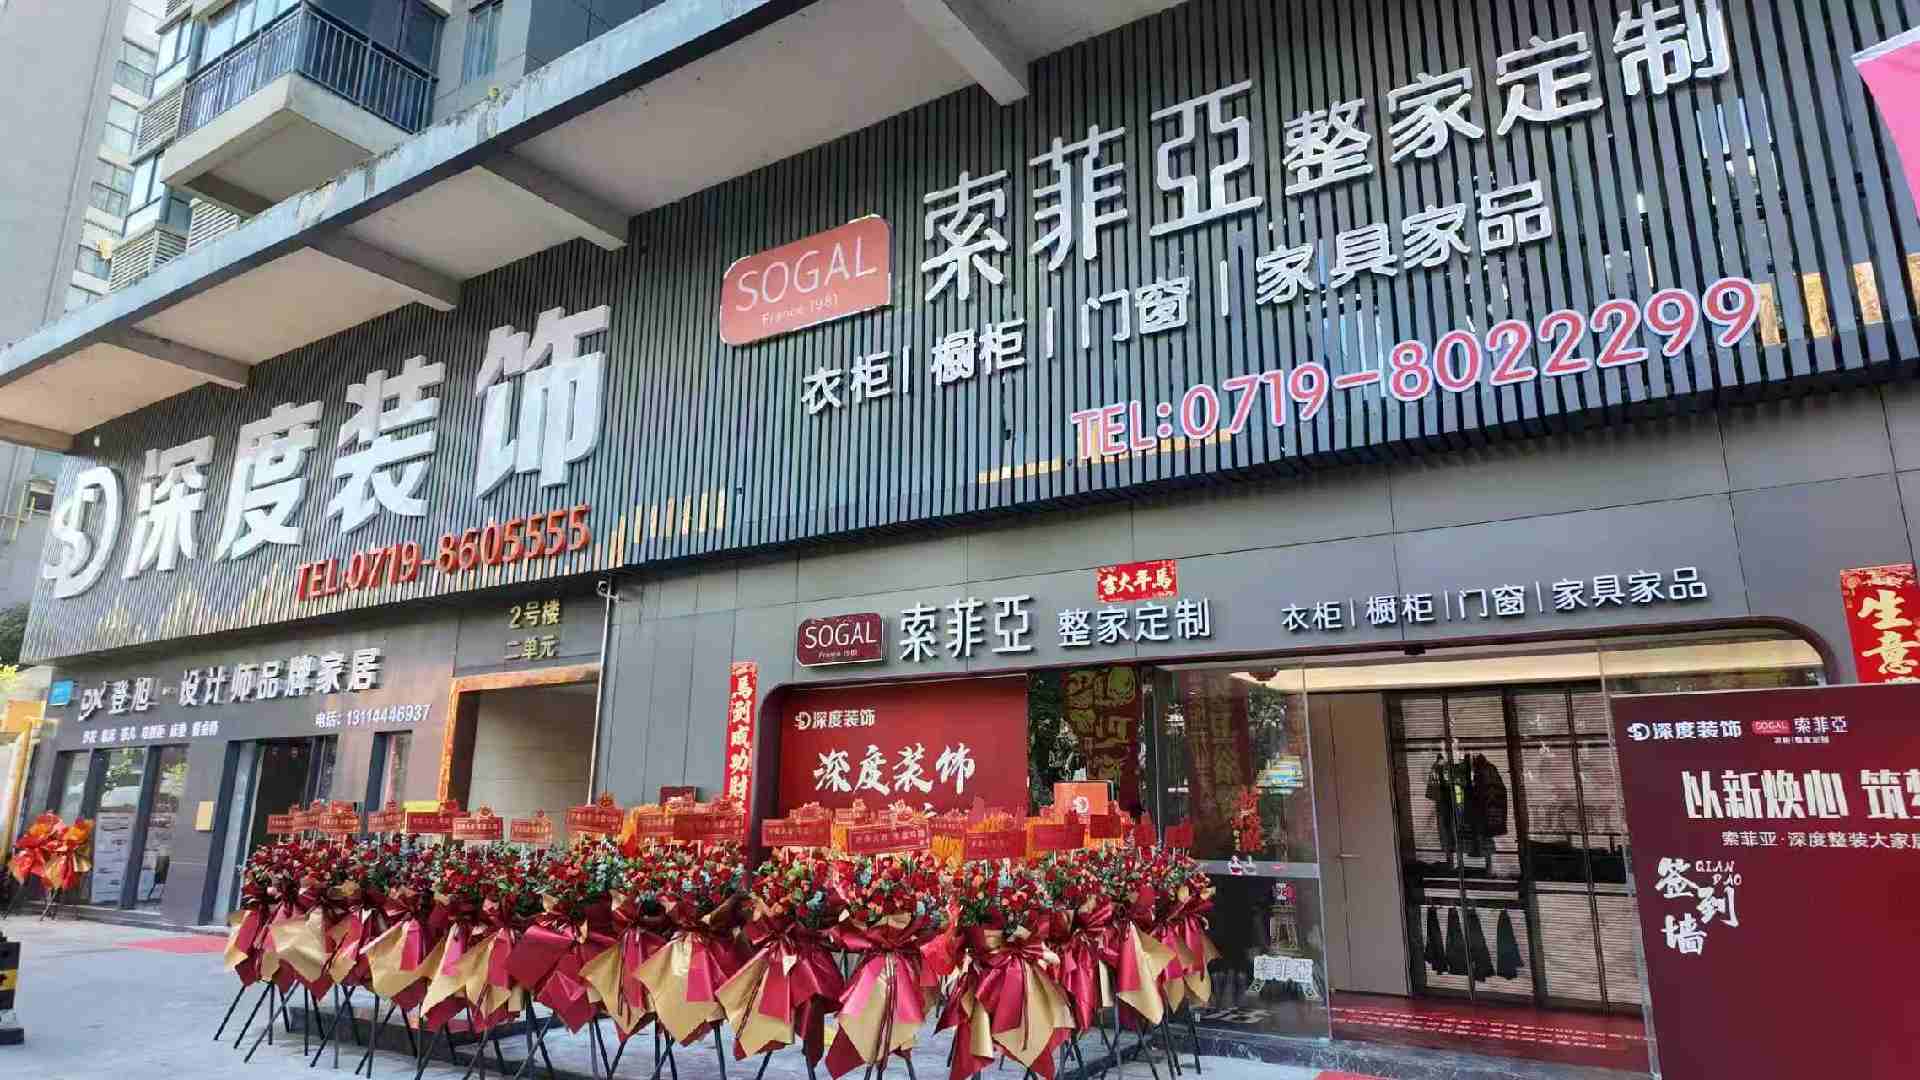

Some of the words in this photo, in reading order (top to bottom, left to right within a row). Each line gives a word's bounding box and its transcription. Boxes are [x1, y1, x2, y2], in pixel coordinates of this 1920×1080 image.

[1284, 0, 1731, 197] 整家定制
[1255, 180, 1552, 306] 家具家品
[735, 236, 878, 311] SOGAL
[809, 292, 839, 313] 1981
[122, 304, 611, 580] 深度装饰
[1550, 566, 1709, 612] 家具家品
[509, 599, 560, 629] 2号楼
[804, 621, 878, 649] SOGAL
[1057, 598, 1211, 648] 整家定制
[1857, 589, 1920, 684] 生意
[504, 634, 556, 660] 二单元
[178, 646, 384, 707] 设计师品牌家居
[812, 709, 877, 729] 深度装饰
[1652, 720, 1743, 741] 深度装饰
[1755, 721, 1789, 732] SOGAL
[813, 742, 976, 797] 深度装饰
[1681, 769, 1850, 819] 以新焕心
[1695, 860, 1735, 873] QIAN
